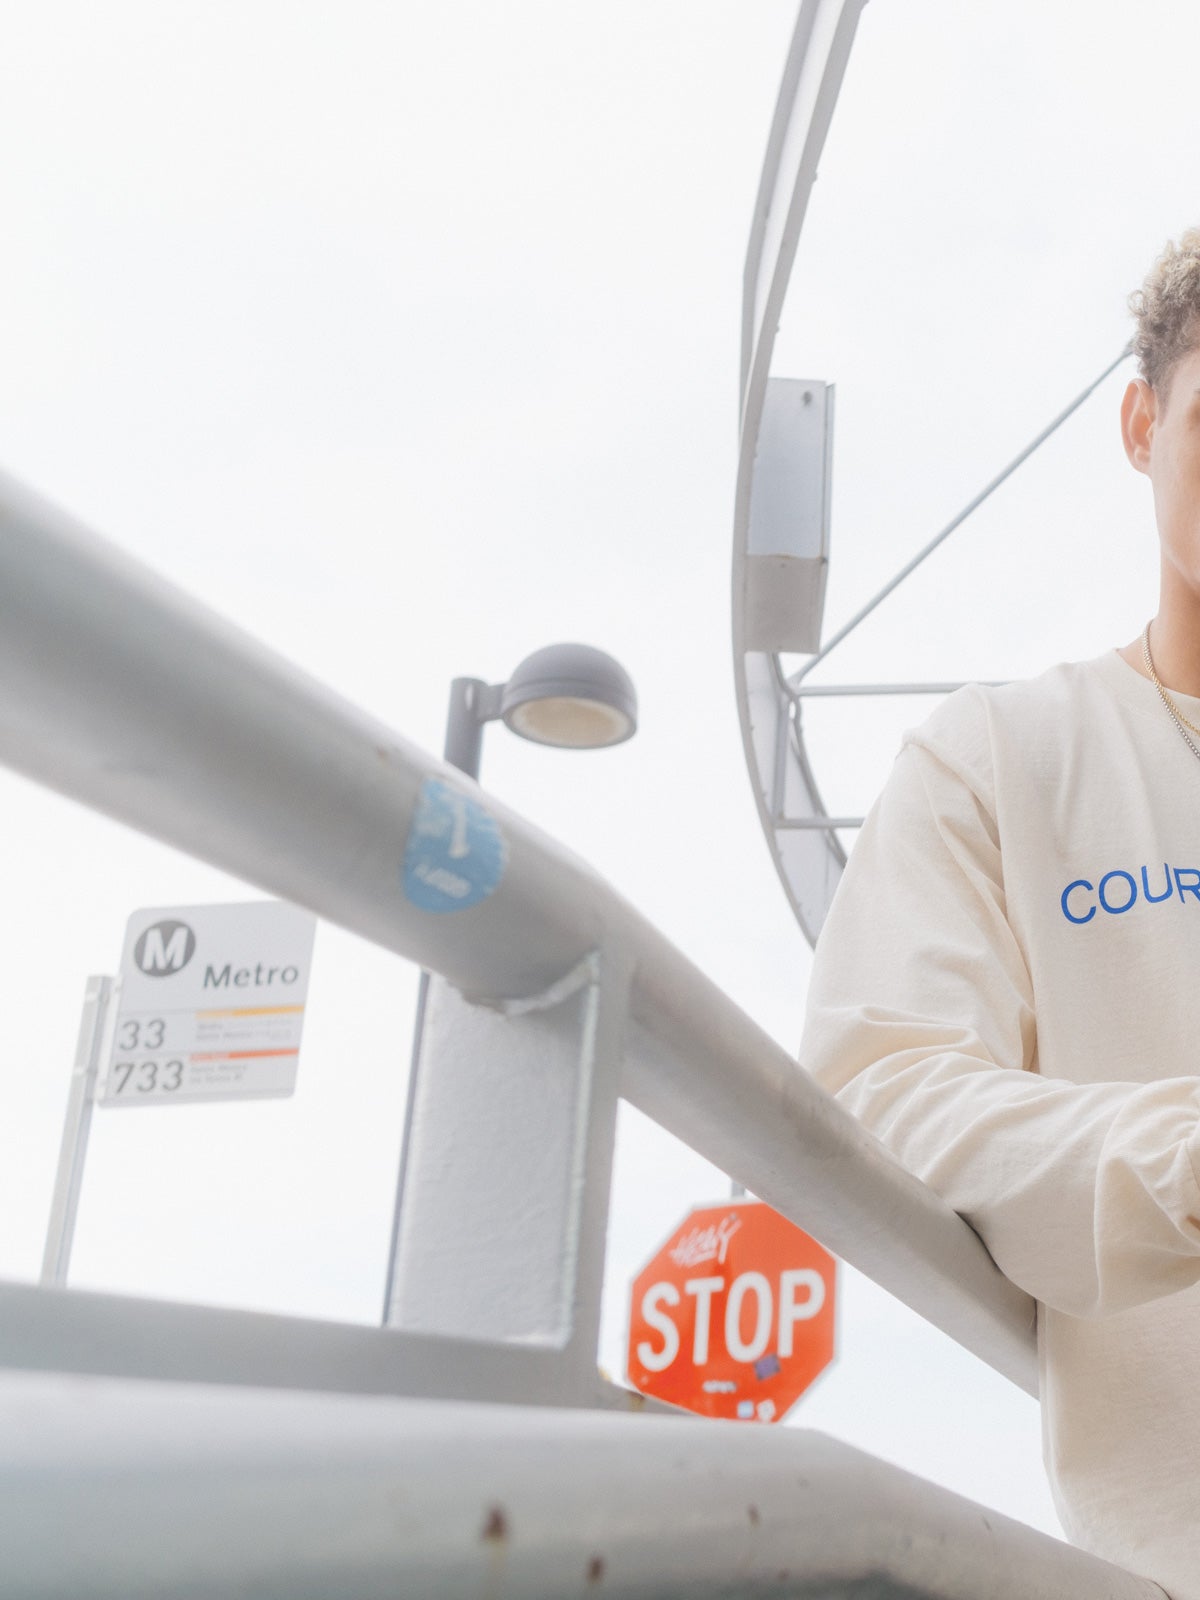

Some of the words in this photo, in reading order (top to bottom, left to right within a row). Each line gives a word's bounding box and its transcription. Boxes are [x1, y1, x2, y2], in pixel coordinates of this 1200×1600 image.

[203, 962, 298, 988] Metro
[120, 1019, 166, 1050] 33
[114, 1061, 184, 1094] 733
[637, 1269, 825, 1372] STOP
